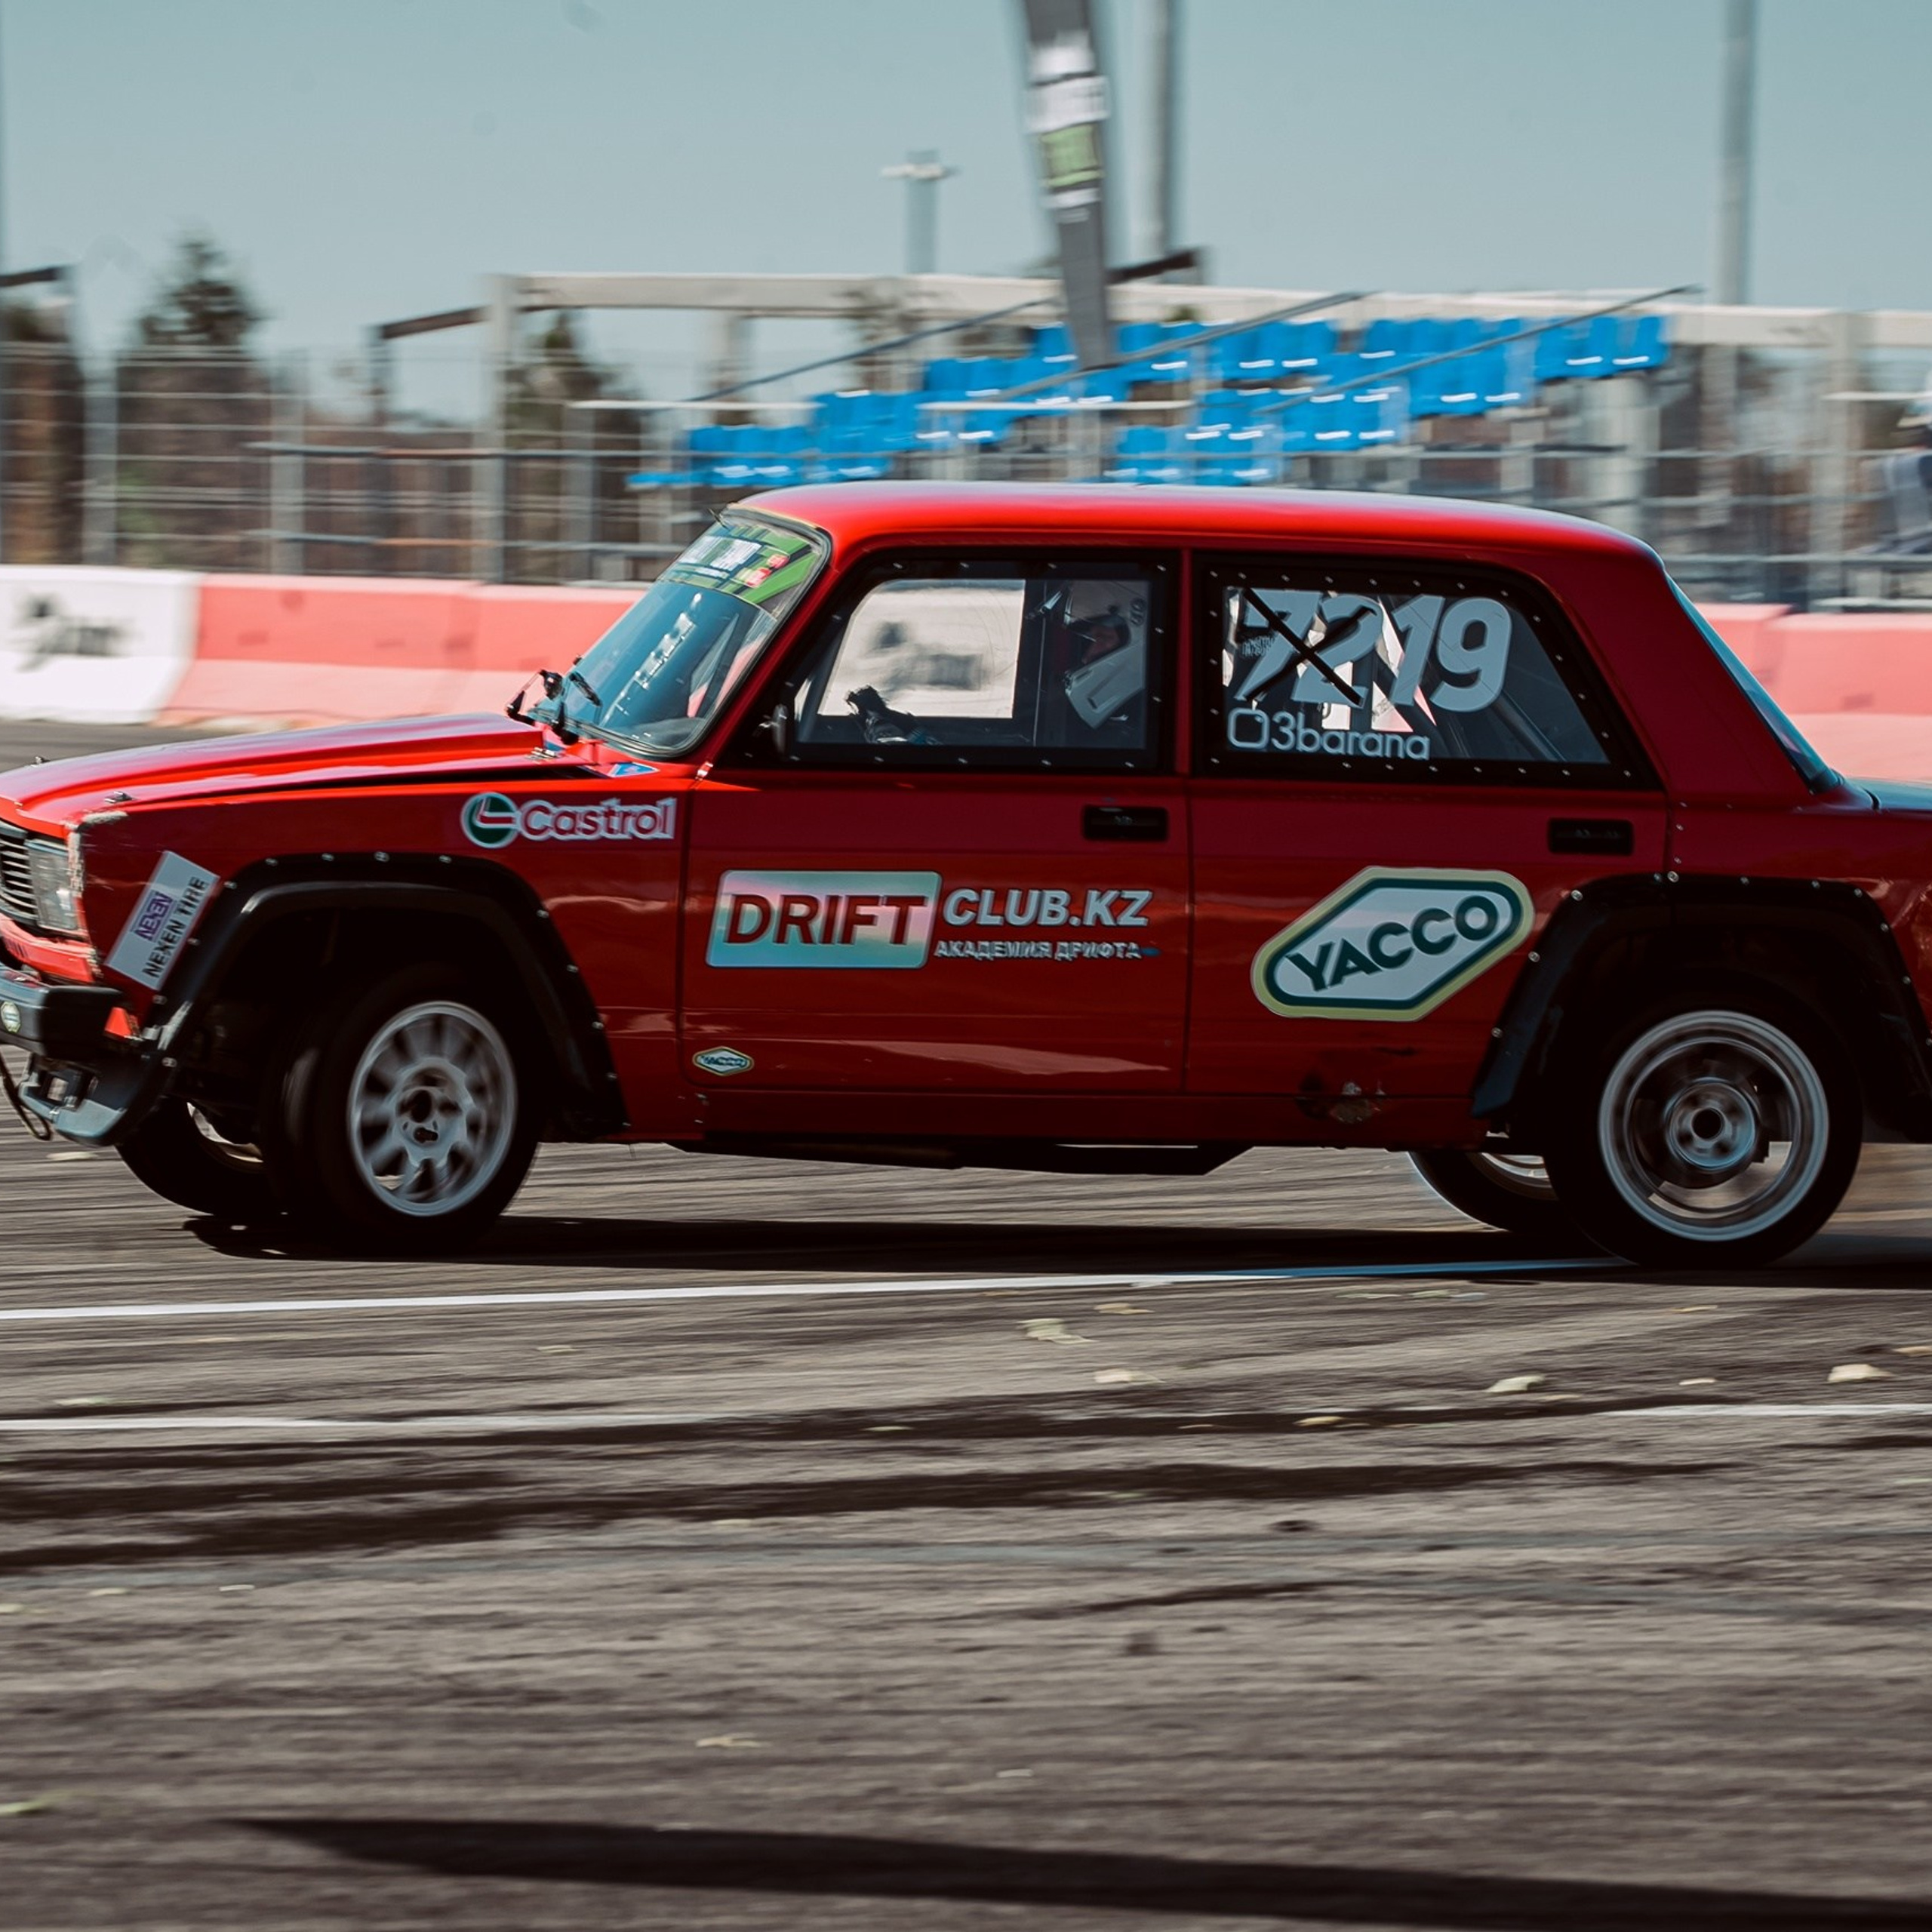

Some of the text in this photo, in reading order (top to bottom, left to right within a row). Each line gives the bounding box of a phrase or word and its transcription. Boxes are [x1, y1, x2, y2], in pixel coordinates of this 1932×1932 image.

[1233, 586, 1512, 712] 7219
[1271, 710, 1430, 761] 3barana
[520, 797, 677, 841] Castrol
[723, 888, 1153, 945] DRIFT CLUB.KZ
[1284, 895, 1500, 992] YACCO
[141, 918, 188, 979] NEXEN
[934, 940, 1142, 961] АКАДЕМИЯ ДРИФТА
